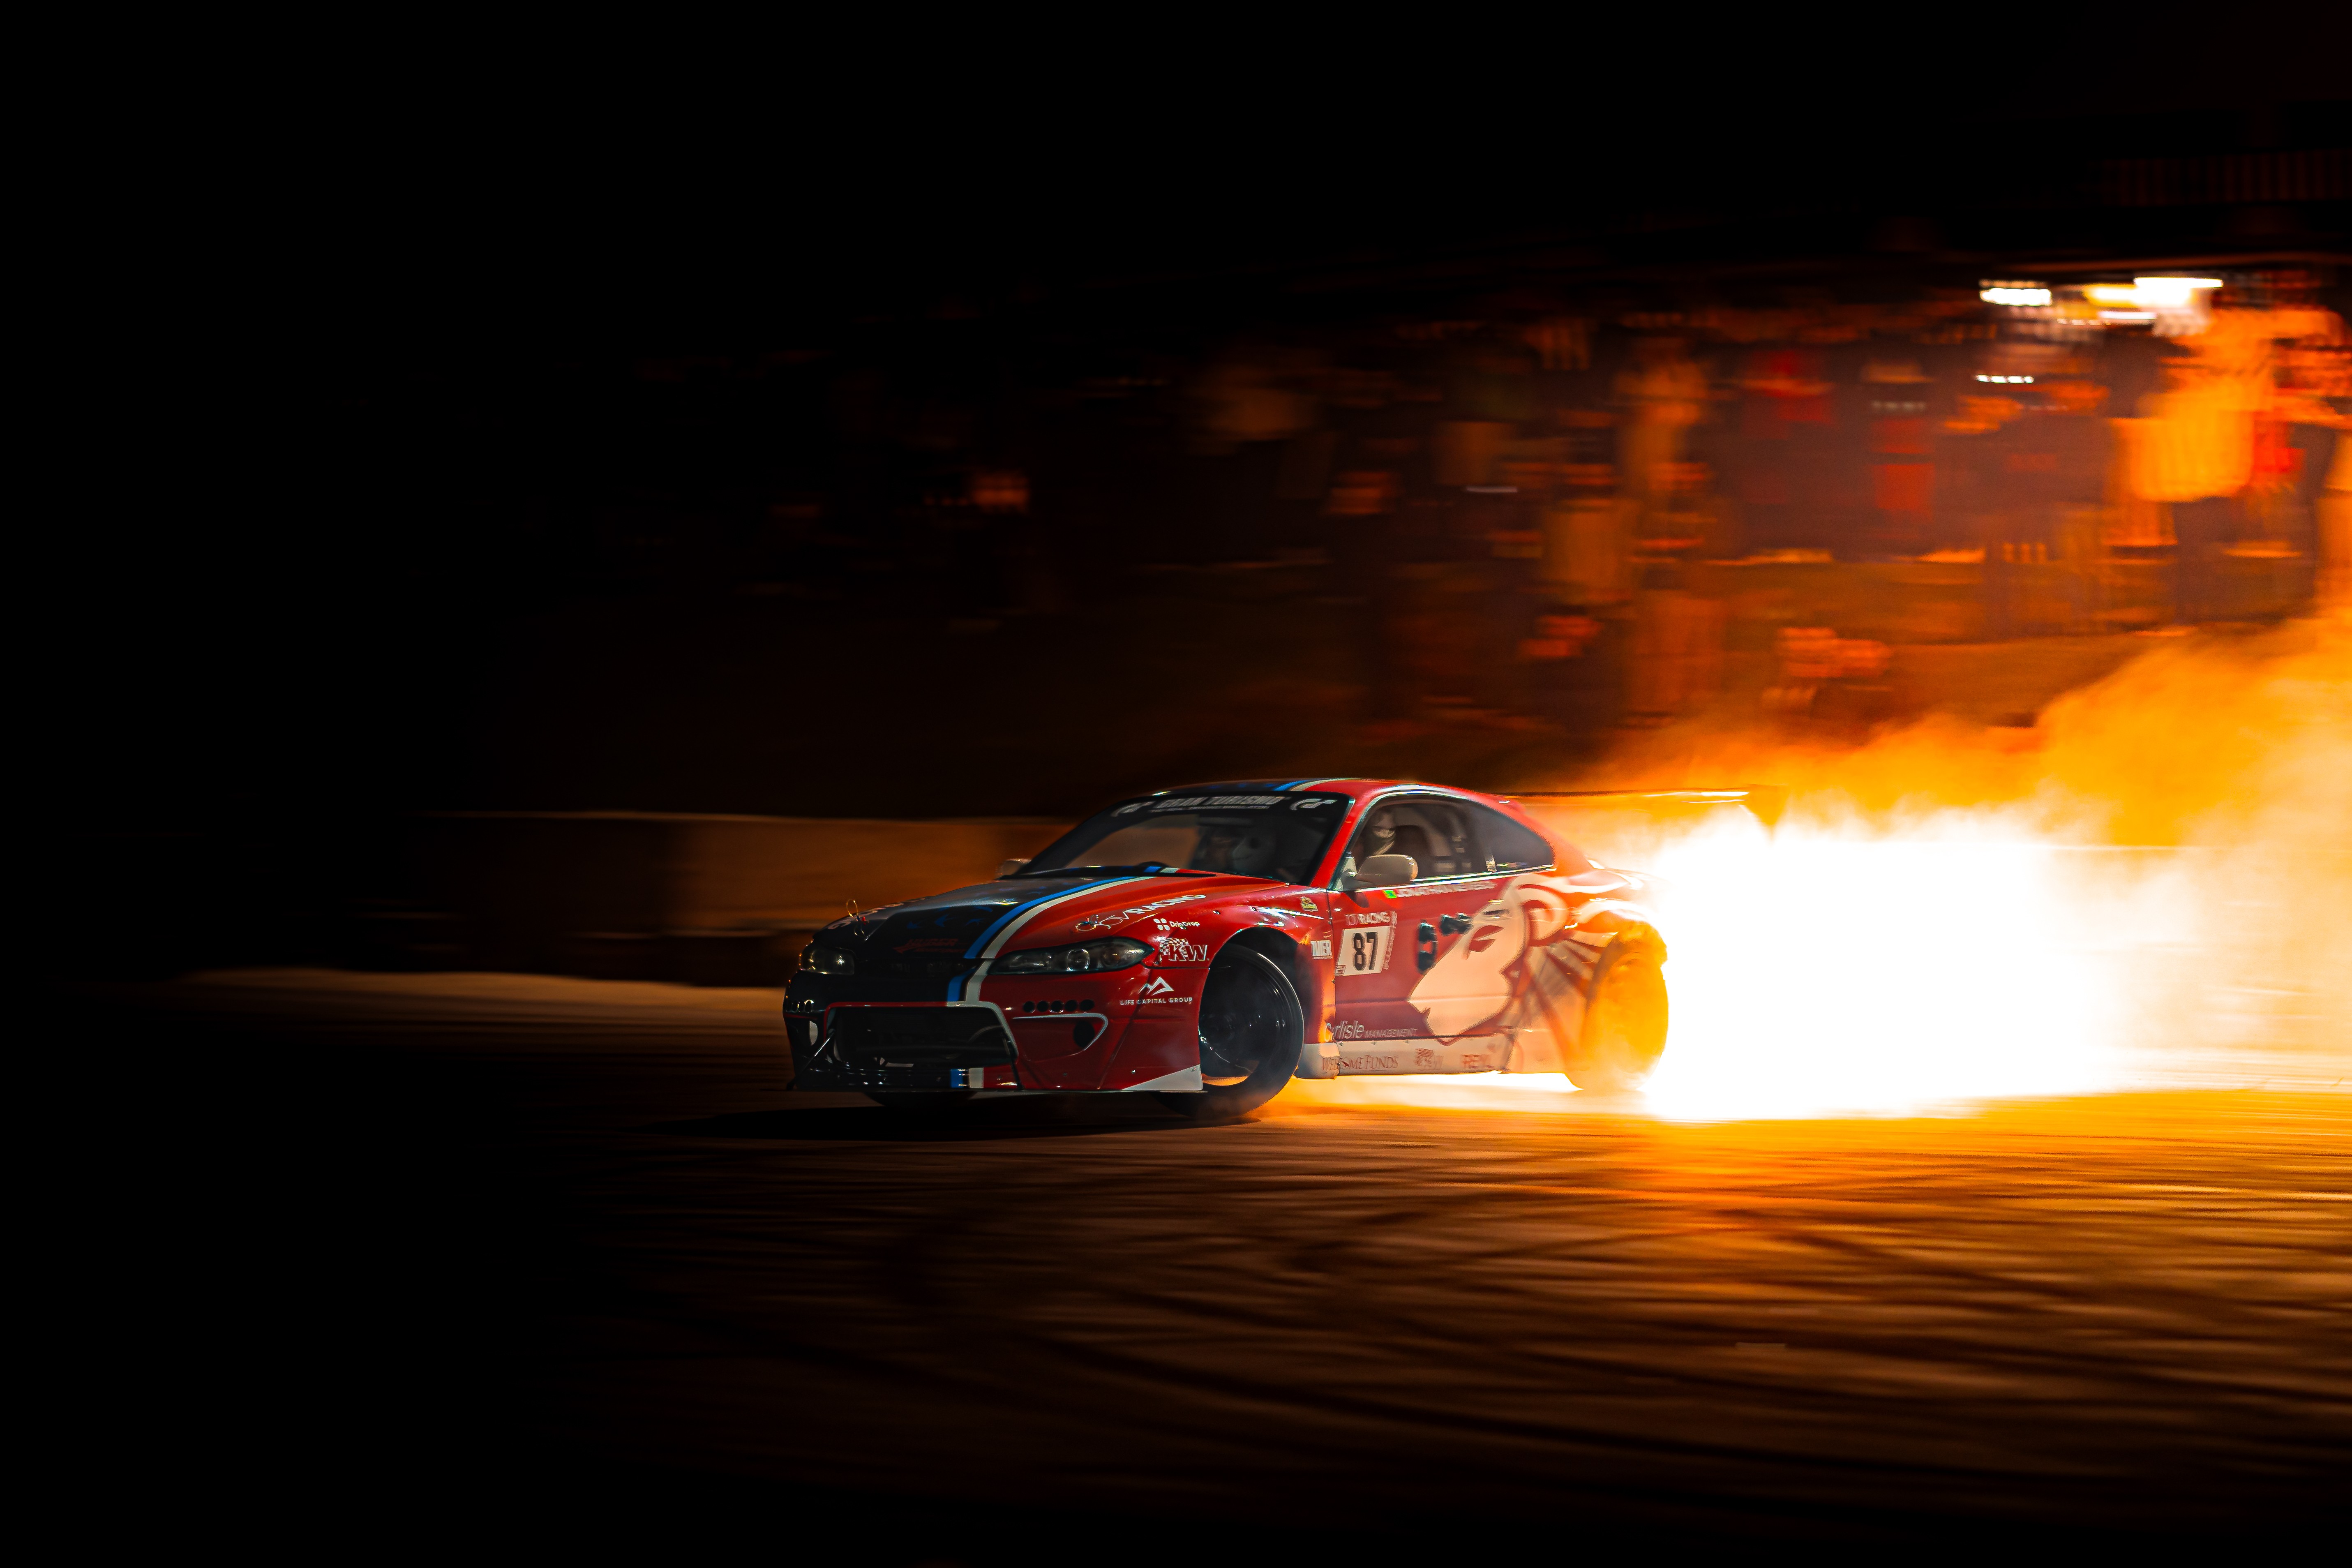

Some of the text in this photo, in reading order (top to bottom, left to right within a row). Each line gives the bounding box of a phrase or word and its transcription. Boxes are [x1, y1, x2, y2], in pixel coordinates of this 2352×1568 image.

[1168, 944, 1208, 961] KW
[1353, 931, 1378, 971] 87
[1365, 1028, 1418, 1038] MANAGEMENT
[1364, 1054, 1398, 1069] FUNDS
